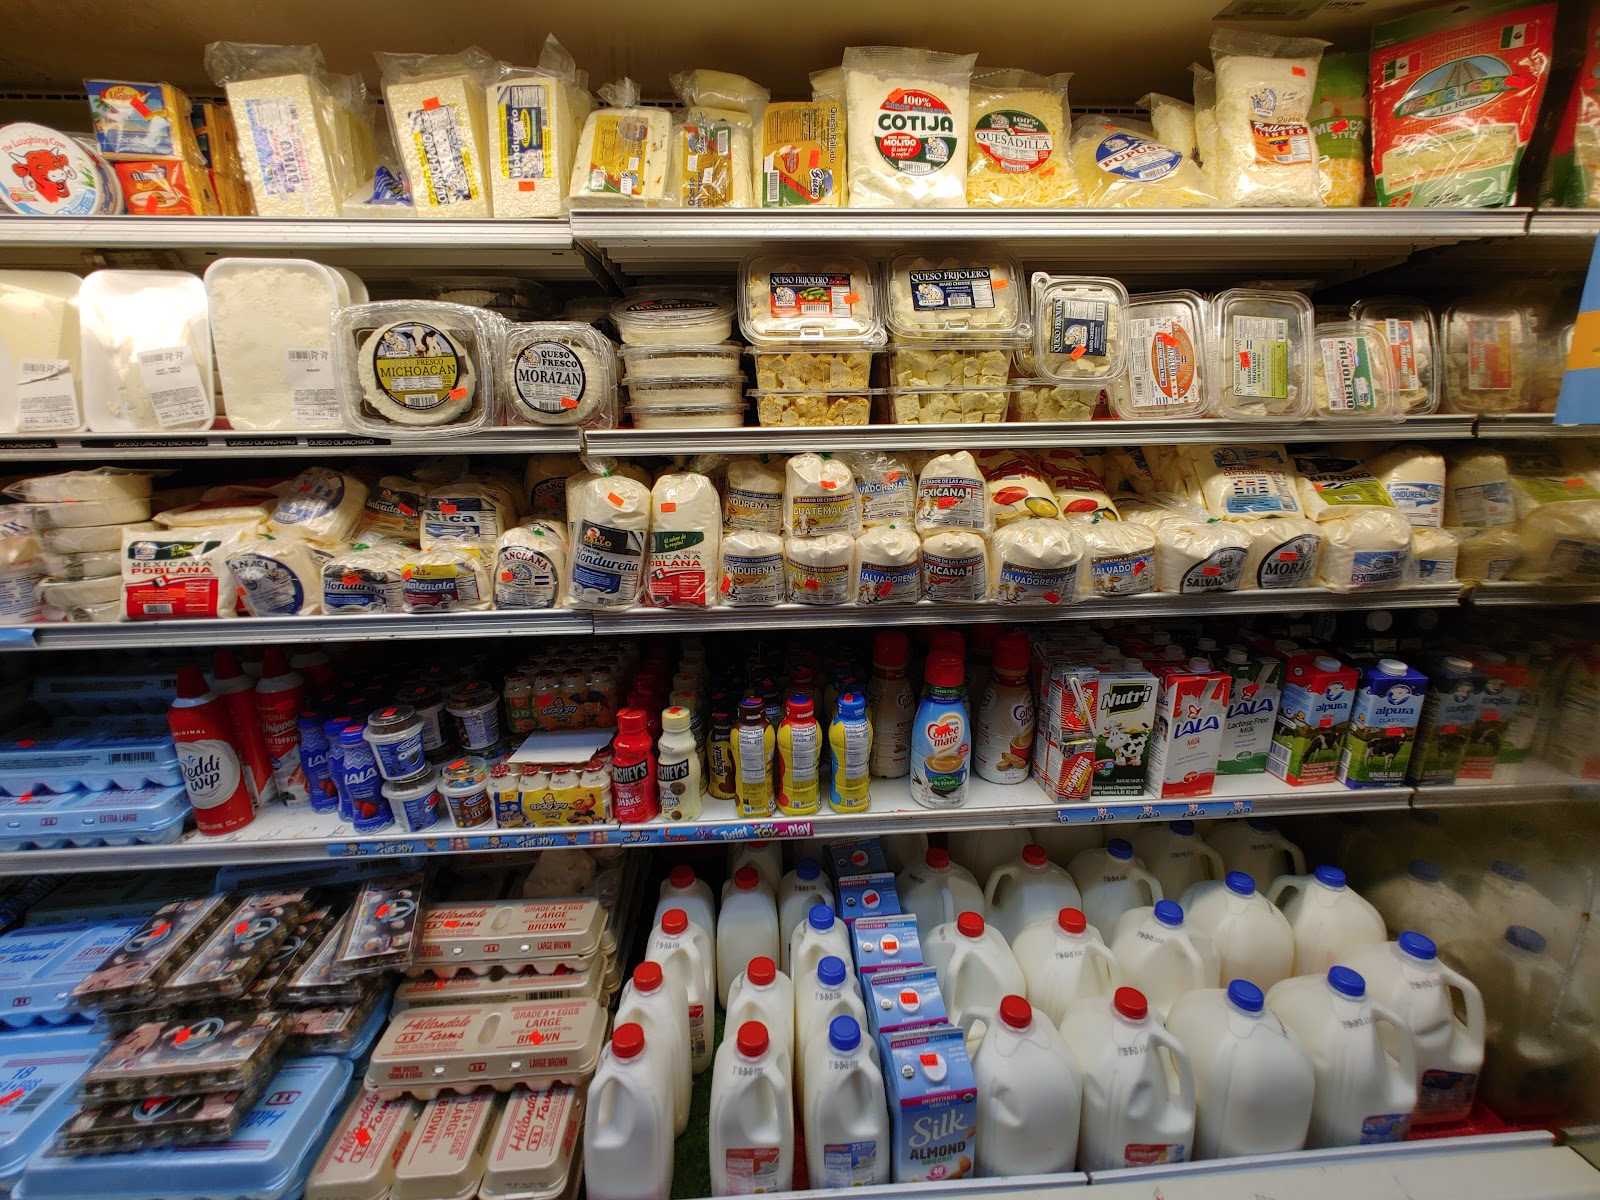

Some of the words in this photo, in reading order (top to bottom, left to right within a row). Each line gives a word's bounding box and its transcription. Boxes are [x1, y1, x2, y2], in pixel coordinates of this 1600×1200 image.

[903, 93, 931, 107] 100%
[1439, 105, 1452, 114] La
[1454, 97, 1486, 110] Ricura
[829, 106, 837, 132] Queso
[877, 113, 954, 133] COTIJA
[1012, 116, 1039, 126] 100%
[976, 132, 1050, 150] QUESADILLA
[1331, 132, 1358, 140] STYLE
[2, 142, 11, 154] The
[11, 135, 49, 148] Laughing
[49, 136, 66, 150] Cow
[883, 138, 917, 147] MOLIDO
[829, 134, 838, 164] Rallado
[280, 140, 301, 186] DURO
[771, 275, 795, 285] QUESO
[795, 274, 829, 286] FRIJOLERO
[911, 272, 943, 283] QUESO
[943, 269, 990, 282] FRIJOLERO
[1053, 329, 1061, 353] QUESO
[541, 350, 570, 360] QUESO
[416, 358, 444, 367] FRESCO
[541, 358, 578, 369] FRESCO
[1167, 348, 1177, 377] RIJOLERO
[380, 364, 456, 378] MICHOACAN
[518, 368, 581, 386] MORAZAN
[1337, 340, 1355, 409] FRIJOLERO
[334, 438, 375, 446] OLANCHANO
[1330, 472, 1373, 481] PEDRO
[919, 488, 965, 498] MEXICANA
[793, 505, 850, 515] GUATEMALA
[425, 512, 476, 523] Nica
[576, 547, 639, 572] Hondureña
[131, 567, 213, 575] POBLANA
[923, 562, 966, 576] EXICANA
[1101, 686, 1152, 711] Nutri
[1226, 698, 1274, 719] LALA
[1315, 702, 1348, 714] alpura
[1375, 705, 1415, 717] alpura
[1174, 715, 1220, 740] LALA
[1227, 719, 1253, 730] Lactose
[1253, 716, 1270, 726] Free
[1240, 725, 1255, 735] Milk
[934, 735, 958, 747] mate
[1186, 737, 1202, 747] Milk
[181, 754, 221, 780] Reddi
[613, 761, 648, 783] RSHEY'S
[657, 759, 689, 781] SHEY'S
[345, 768, 379, 786] LALA
[940, 778, 956, 786] SUGAR
[100, 814, 118, 824] EXTRA
[118, 813, 138, 823] LARGE
[720, 826, 750, 841] Twist
[754, 828, 779, 838] TOY
[788, 823, 811, 836] Play
[515, 835, 527, 845] WE
[519, 840, 536, 849] THE
[537, 837, 555, 847] JOY
[374, 843, 385, 851] WE
[379, 845, 396, 855] THE
[397, 843, 414, 854] JOY
[427, 908, 488, 921] Hillandale
[525, 905, 550, 913] GRADE
[535, 911, 568, 920] LARGE
[527, 922, 567, 931] BROWN
[856, 923, 886, 931] UNSWEETENED
[537, 942, 554, 951] LARGE
[554, 940, 573, 950] BROWN
[514, 1010, 543, 1020] GRADE
[557, 1008, 580, 1017] EGGS
[404, 1015, 472, 1031] Hillandale
[525, 1017, 562, 1028] LARGE
[425, 1031, 465, 1041] Farms
[517, 1032, 560, 1045] BRWN
[891, 1038, 928, 1049] UNSWEETENED
[929, 1034, 950, 1043] VANILLA
[407, 1042, 435, 1050] DOZEN
[403, 1065, 420, 1073] DOZEN
[529, 1058, 549, 1069] LARGE
[549, 1057, 568, 1068] BROWN
[14, 1066, 38, 1081] 18
[921, 1094, 958, 1105] UNSWEETENED
[422, 1100, 447, 1145] BROWN
[448, 1101, 466, 1139] LARGE
[908, 1108, 969, 1148] Silk
[449, 1128, 467, 1155] EGGS
[909, 1140, 966, 1161] ALMOND
[931, 1166, 944, 1175] 40
